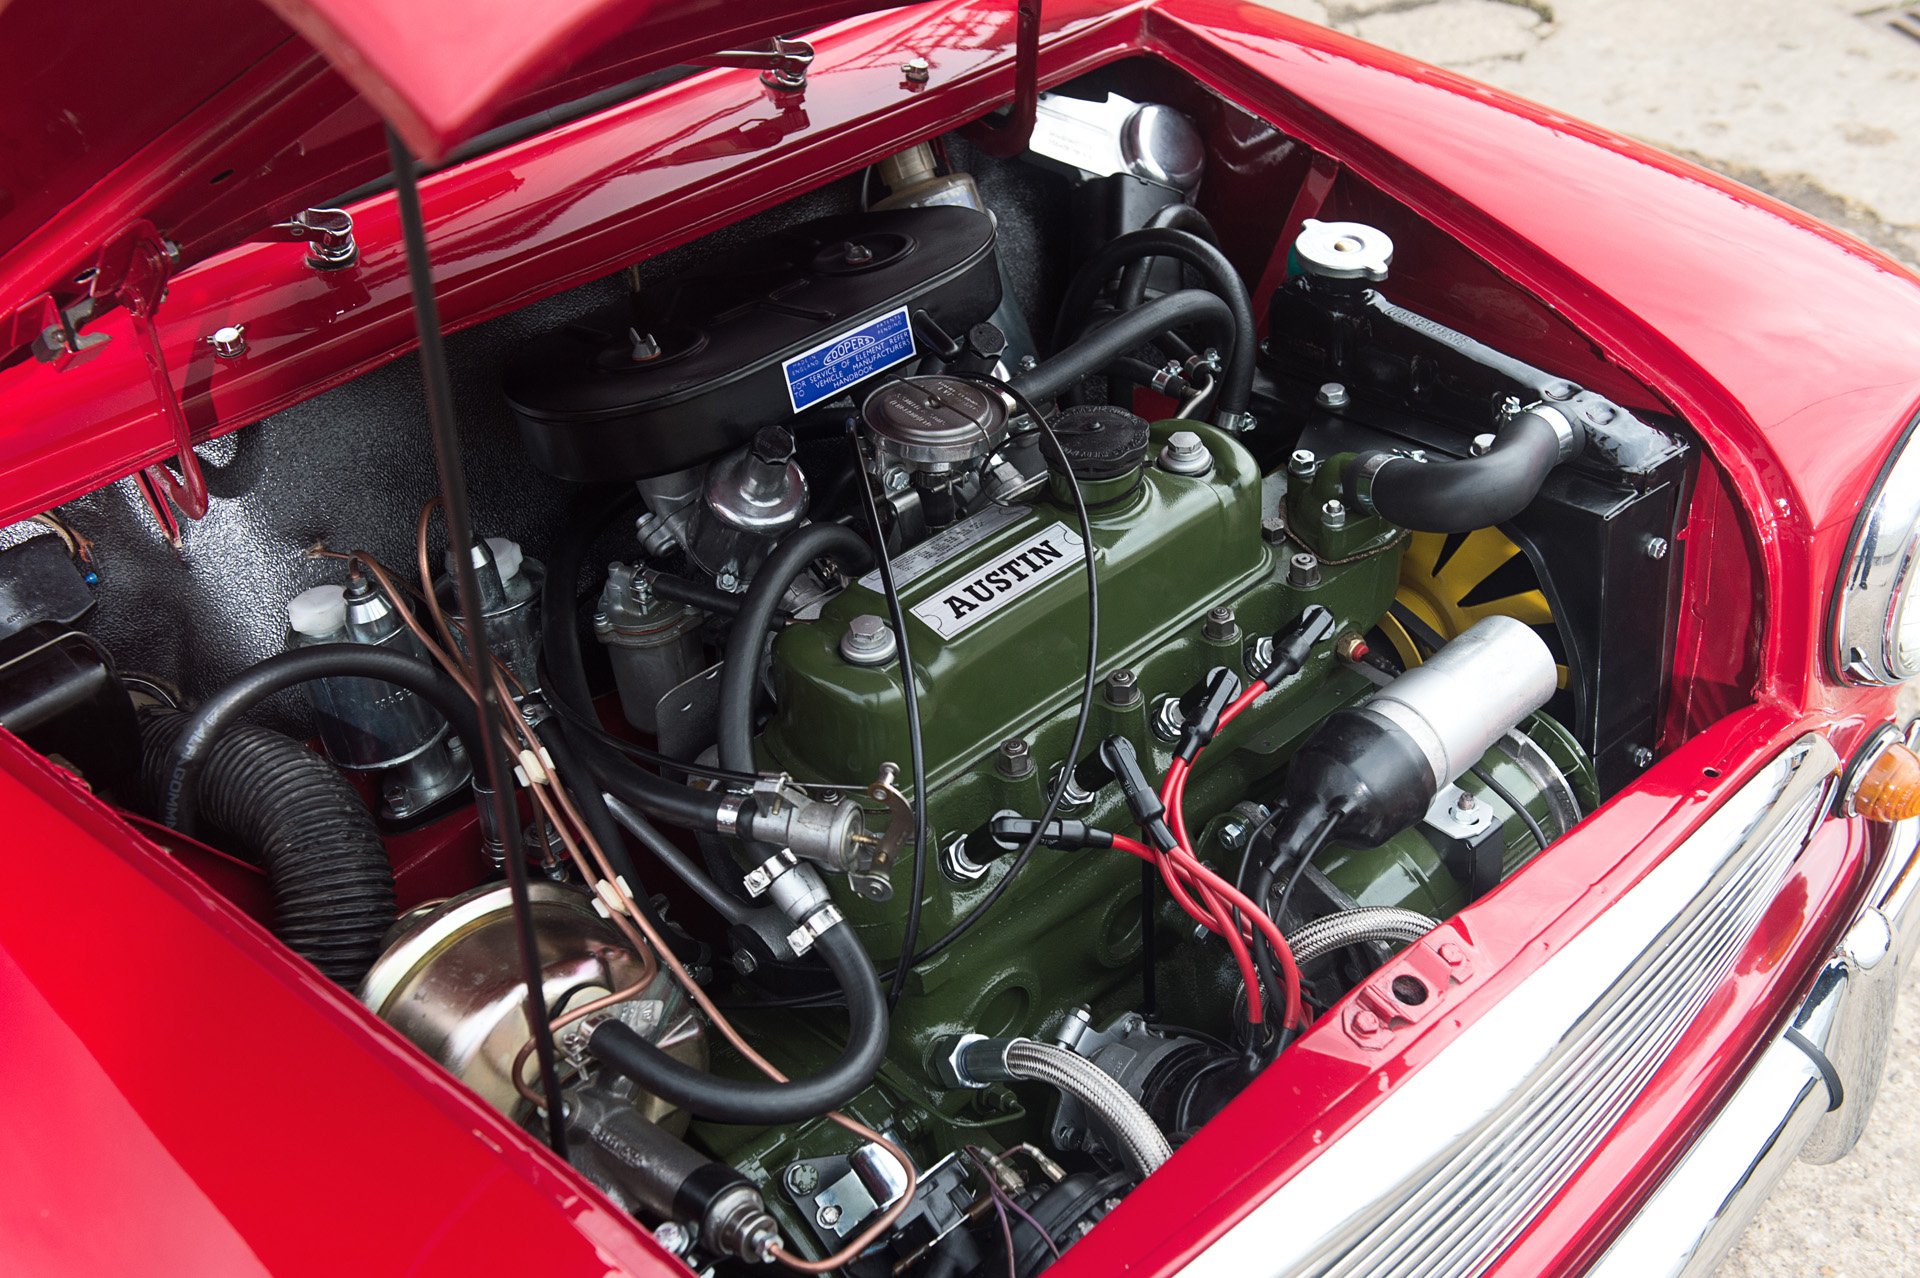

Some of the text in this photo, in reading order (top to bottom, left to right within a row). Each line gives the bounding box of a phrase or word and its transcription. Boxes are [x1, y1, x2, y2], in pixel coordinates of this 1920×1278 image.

[877, 321, 903, 335] PENDING
[792, 354, 817, 369] MADE IN
[792, 331, 909, 392] FOR SERVICE OF ELEMENT REFER
[826, 337, 870, 362] COOPERS
[791, 360, 819, 376] ENGLAND
[794, 340, 911, 398] TO VEHICLE MANUFACTURERS
[832, 366, 874, 389] HANDBOOK
[942, 539, 1064, 620] AUSTIN
